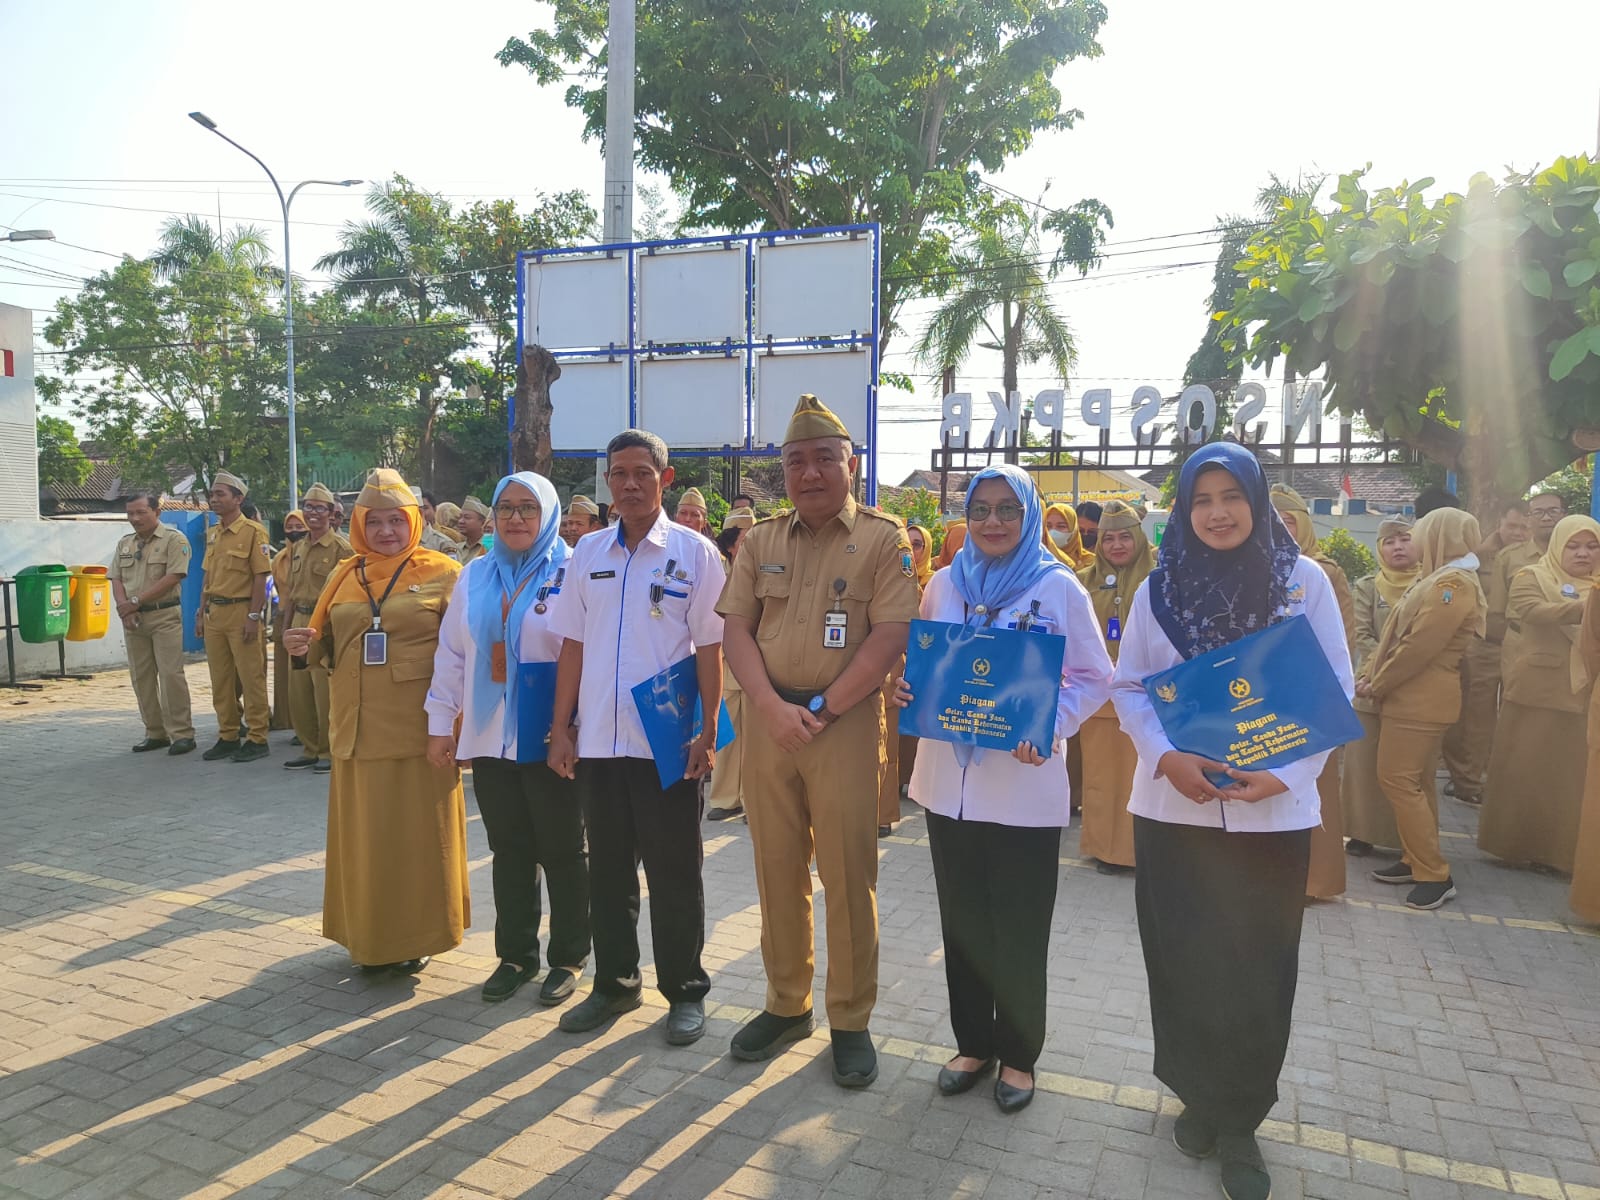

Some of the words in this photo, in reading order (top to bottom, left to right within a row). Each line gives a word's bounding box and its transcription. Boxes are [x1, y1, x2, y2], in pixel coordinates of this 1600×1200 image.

[960, 694, 996, 708] Piagam
[942, 722, 972, 733] Republik
[973, 726, 1006, 738] Indonesia
[1235, 713, 1278, 735] Piagam
[1235, 750, 1269, 767] Republik
[1269, 737, 1308, 755] Indonesia
